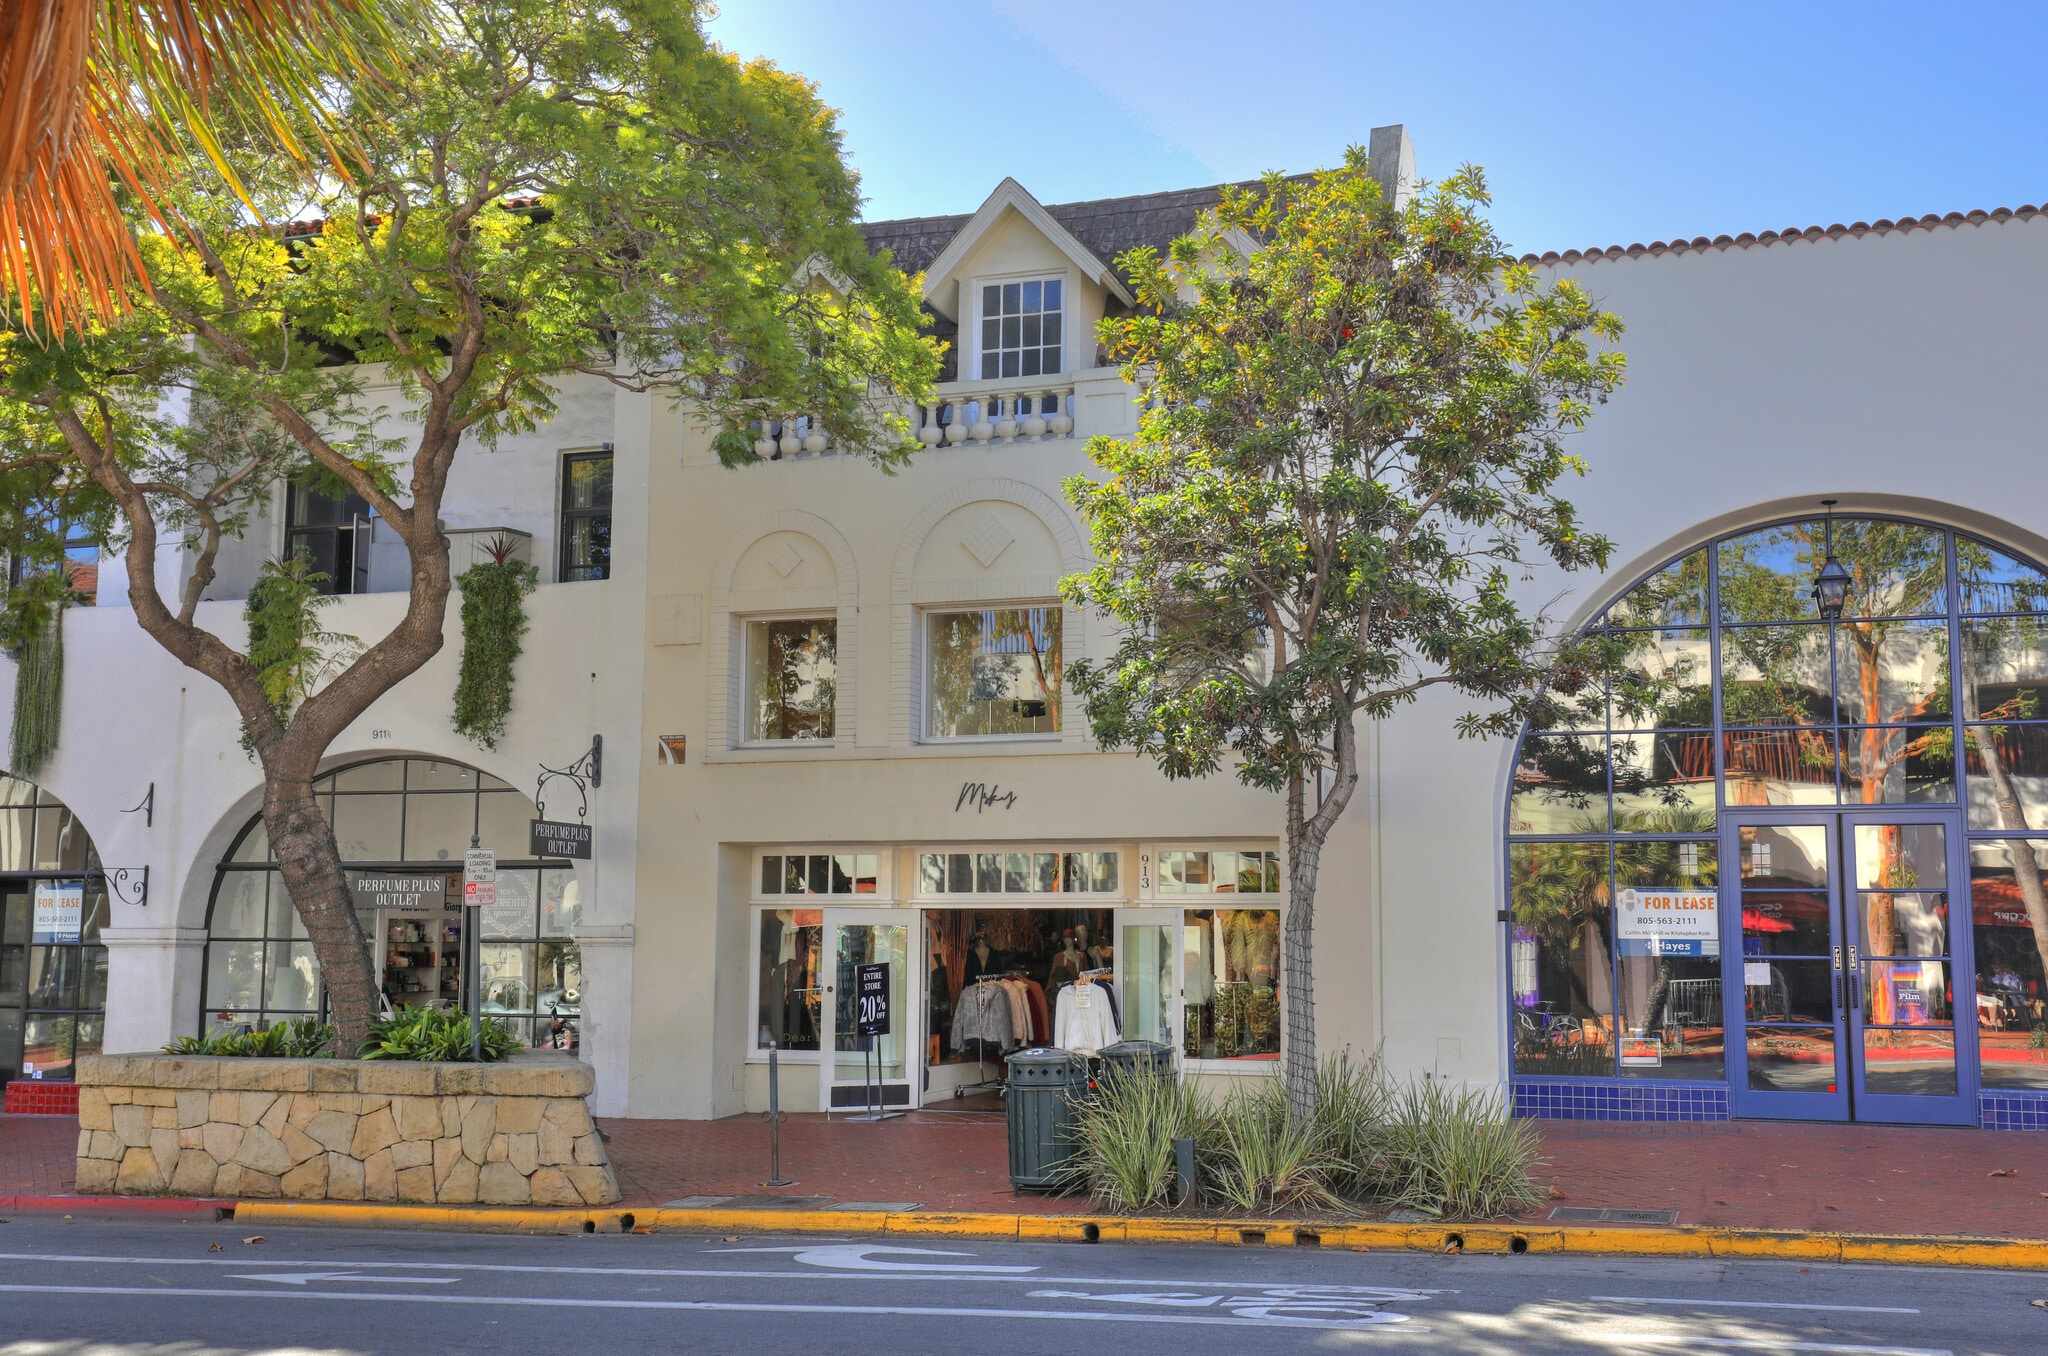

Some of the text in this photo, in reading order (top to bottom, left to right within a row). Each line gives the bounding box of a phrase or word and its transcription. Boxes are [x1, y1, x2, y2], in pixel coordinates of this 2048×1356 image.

[535, 823, 589, 841] PERFUME PLUS
[548, 840, 577, 855] OUTLET
[1141, 854, 1150, 889] 913
[358, 879, 440, 892] PERFUME PLUS
[467, 886, 476, 894] NO
[499, 888, 519, 896] 100%
[38, 898, 80, 908] FOR LEASE
[376, 893, 421, 906] OUTLET
[488, 897, 529, 908] UTHENTIC
[1644, 896, 1715, 910] FOR LEASE
[1637, 917, 1697, 925] 805-563-2111
[1659, 941, 1691, 952] Hayes
[863, 971, 883, 981] ENTIRE
[864, 981, 882, 991] STORE
[1898, 992, 1920, 1000] Film
[859, 994, 886, 1024] 20%
[876, 1011, 886, 1020] OFF
